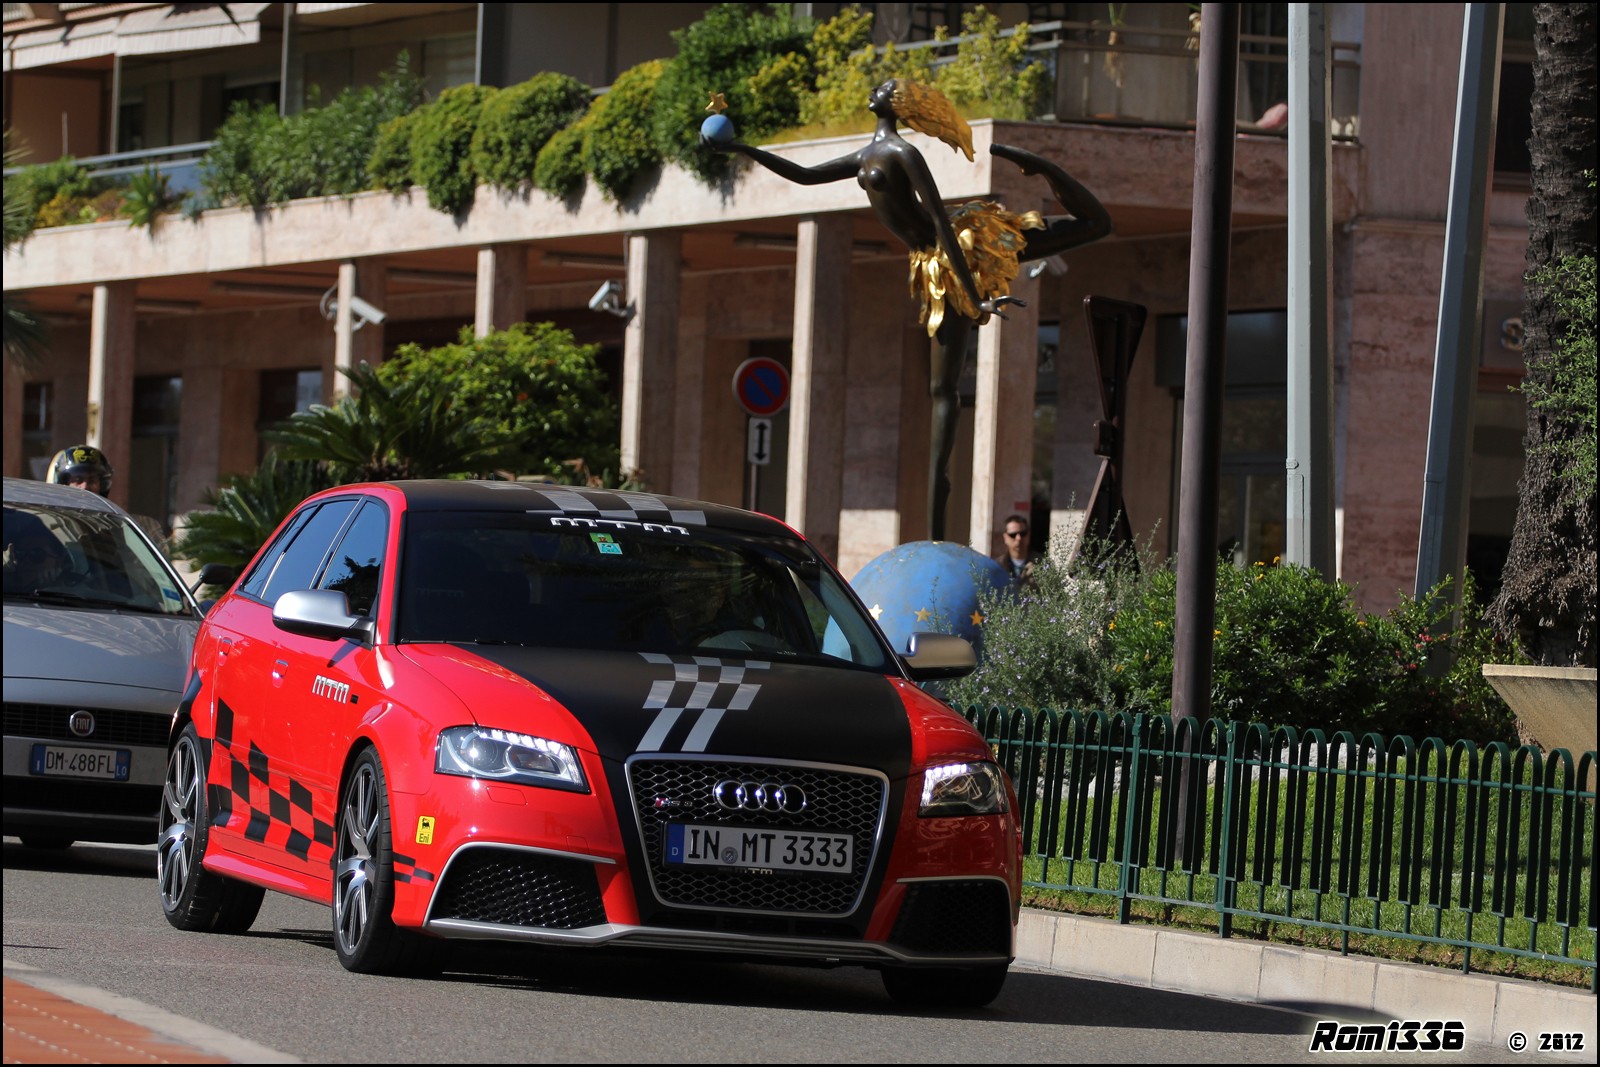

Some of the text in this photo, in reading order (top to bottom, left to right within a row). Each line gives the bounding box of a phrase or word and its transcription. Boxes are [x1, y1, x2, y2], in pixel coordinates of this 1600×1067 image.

[75, 718, 91, 730] FIAT
[116, 765, 127, 776] LO
[419, 833, 430, 844] Eni
[671, 829, 848, 868] D IN MT 3333
